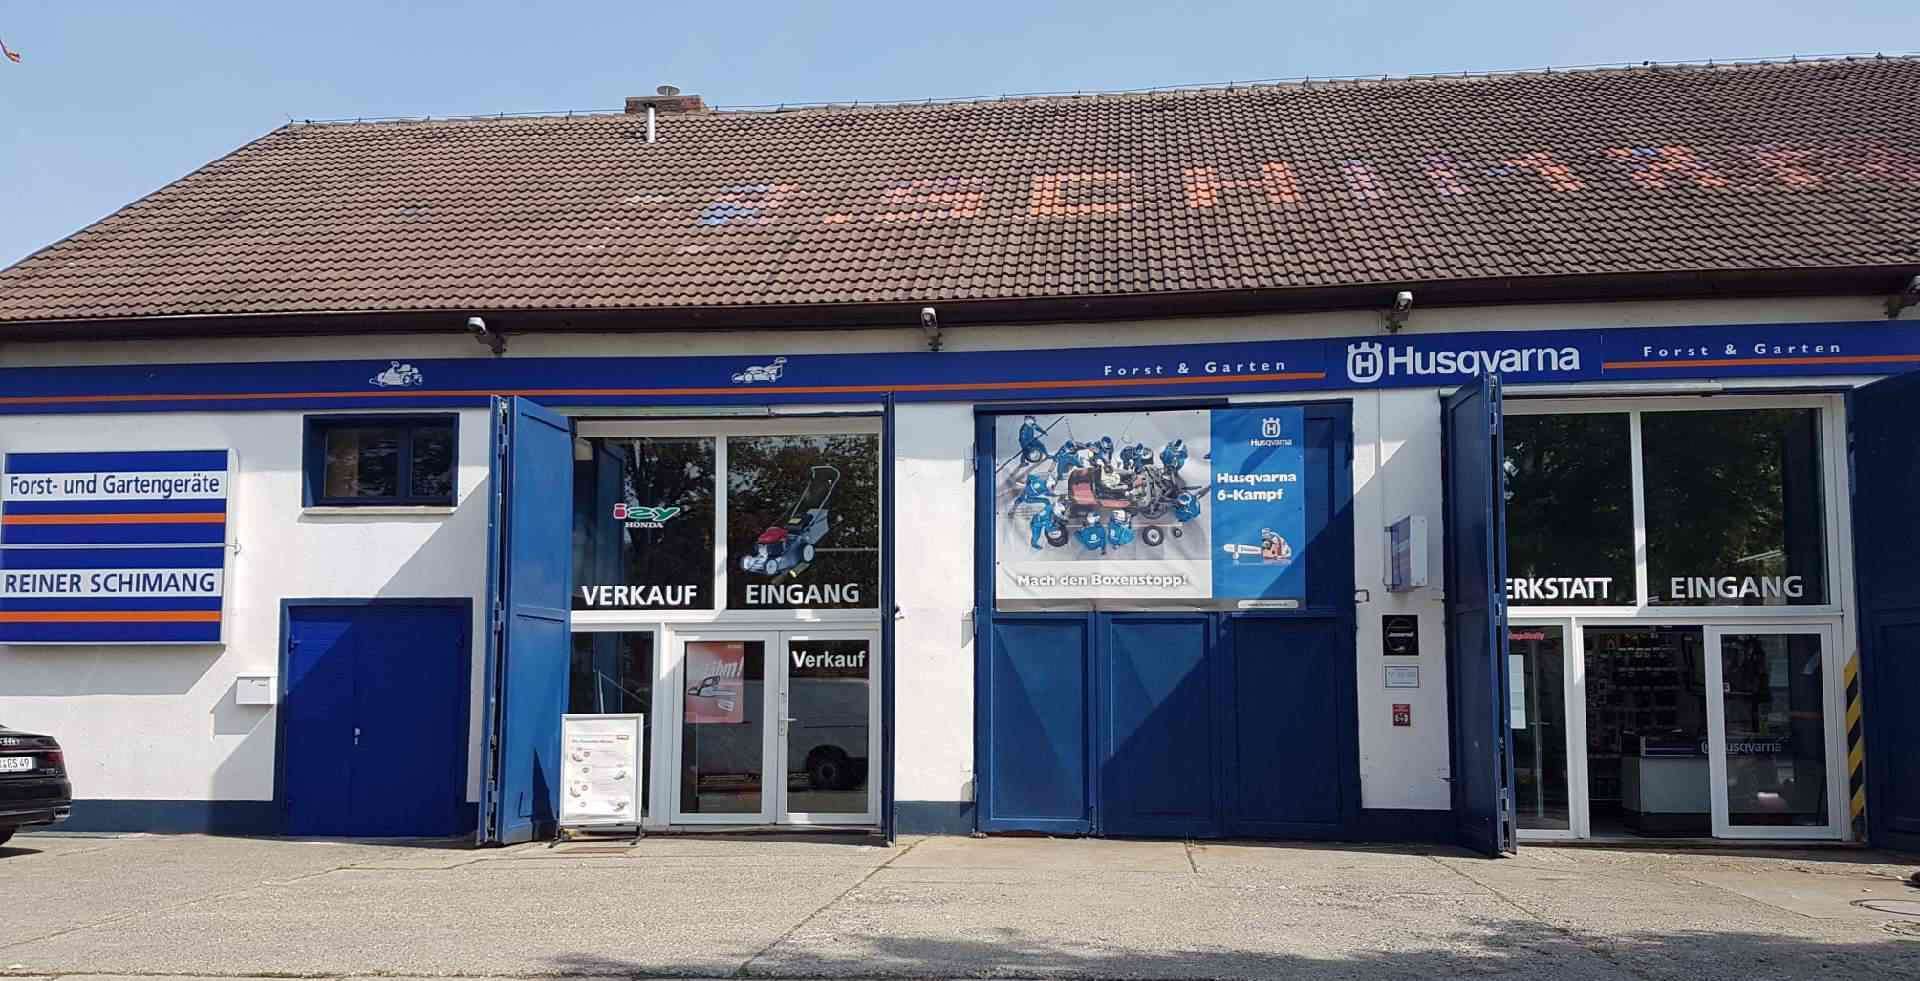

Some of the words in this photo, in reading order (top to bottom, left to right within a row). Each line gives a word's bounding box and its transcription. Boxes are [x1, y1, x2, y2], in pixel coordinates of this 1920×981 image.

[1644, 346, 1708, 358] Forst
[1725, 344, 1737, 355] &
[1754, 343, 1841, 354] Garten
[1104, 365, 1163, 376] Forst
[1177, 363, 1189, 374] &
[1205, 361, 1286, 373] Garten
[1388, 346, 1581, 377] Husqvarna
[1250, 439, 1292, 447] Husqvarna
[10, 476, 57, 495] Forst-
[64, 474, 97, 494] und
[103, 473, 220, 498] Gartengeräte
[1216, 472, 1297, 486] Husqvarna
[1217, 488, 1284, 502] 6-Kampf
[5, 574, 82, 593] REINER
[90, 572, 216, 593] SCHIMANG
[1016, 574, 1056, 586] Mach
[1060, 574, 1088, 586] den
[1091, 574, 1187, 587] Boxenstopp!
[1505, 577, 1613, 600] ERKSTATT
[1671, 575, 1804, 599] EINGANG
[582, 585, 698, 606] VERKAUF
[746, 582, 860, 605] EINGANG
[792, 650, 867, 668] Verkauf
[1726, 742, 1783, 752] usqvarna
